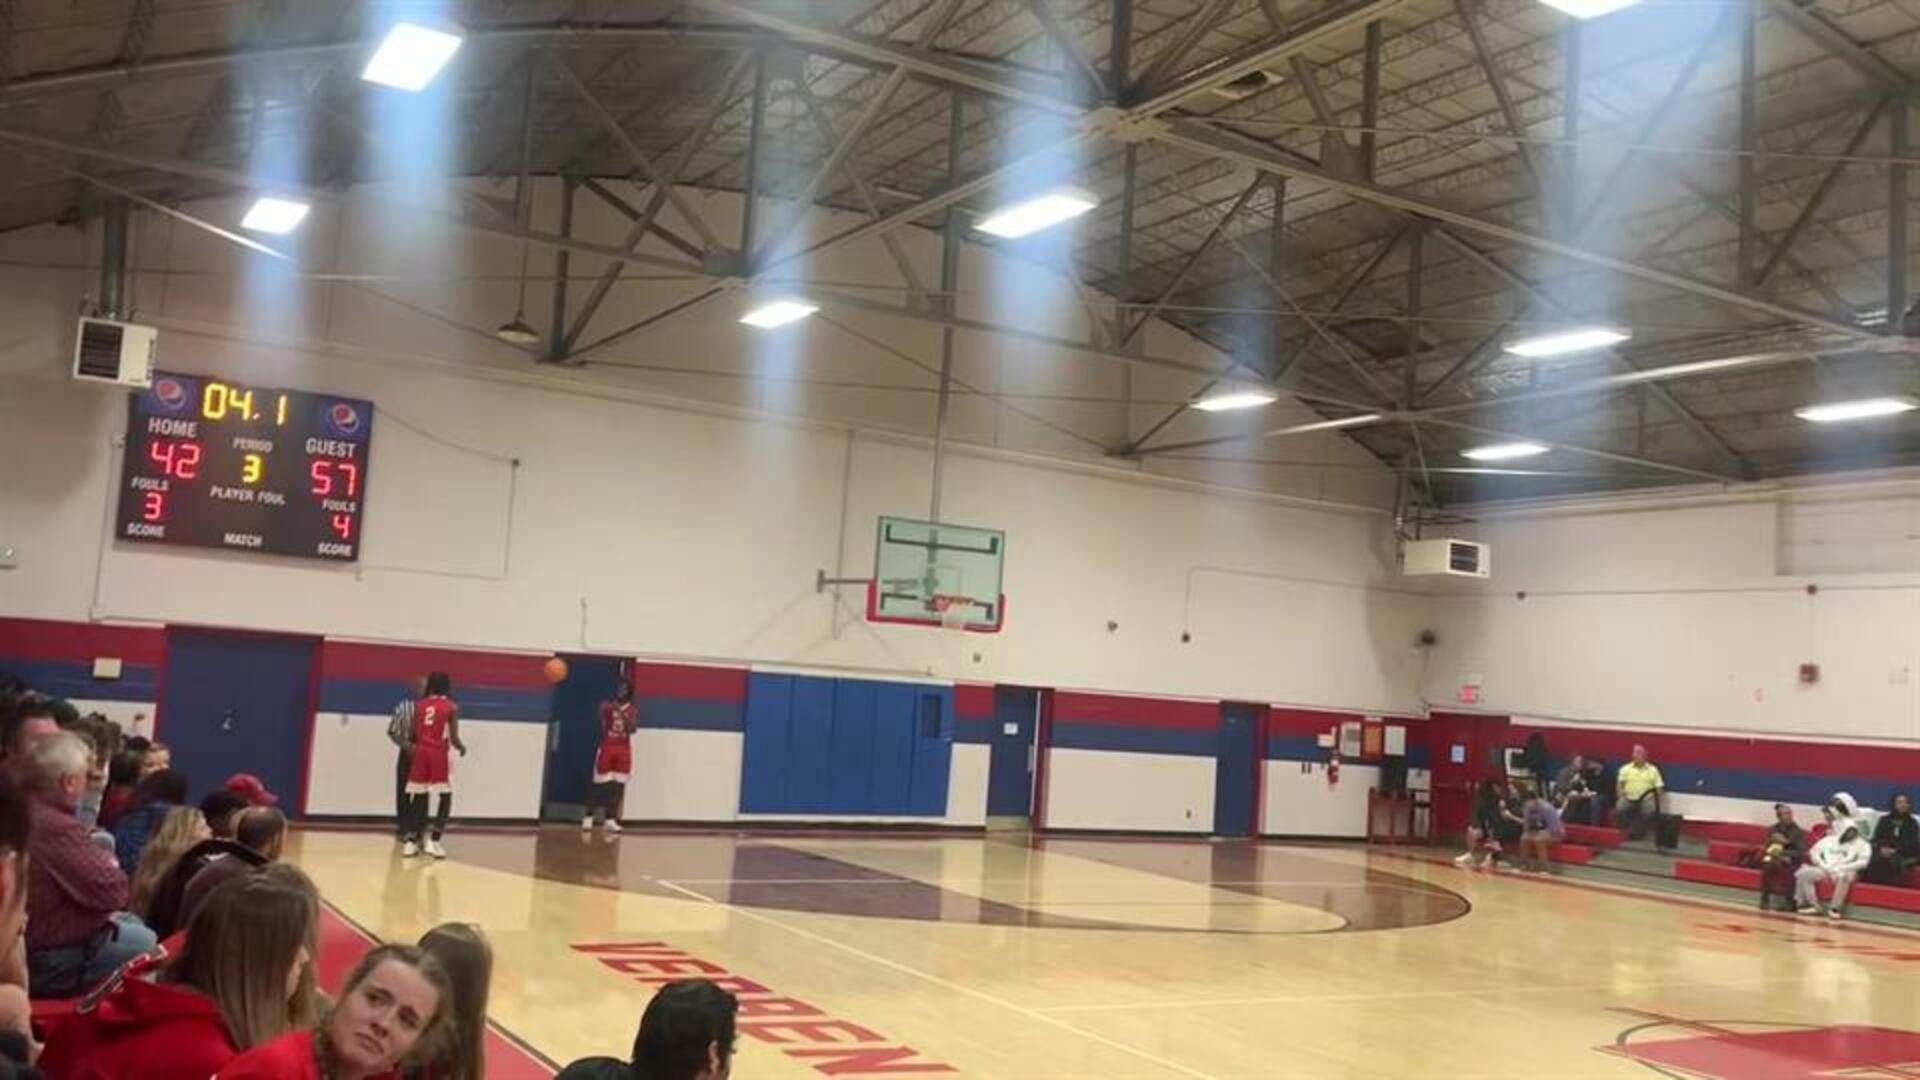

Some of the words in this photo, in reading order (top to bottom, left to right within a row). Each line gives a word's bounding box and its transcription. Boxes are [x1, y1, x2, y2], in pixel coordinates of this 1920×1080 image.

[203, 383, 287, 425] 04.1
[148, 417, 198, 438] HOME
[305, 438, 356, 458] GUEST
[151, 441, 201, 478] 42
[242, 454, 261, 483] 3
[131, 476, 169, 491] FOULS
[311, 461, 356, 496] 57
[210, 485, 254, 501] PLAYER
[257, 491, 286, 505] FOUL
[144, 492, 163, 520] 3
[322, 499, 356, 512] FOULS
[127, 523, 165, 537] SCORE
[333, 514, 350, 538] 4
[224, 532, 263, 547] MATCH
[318, 543, 352, 557] SCORE
[424, 706, 435, 725] 2
